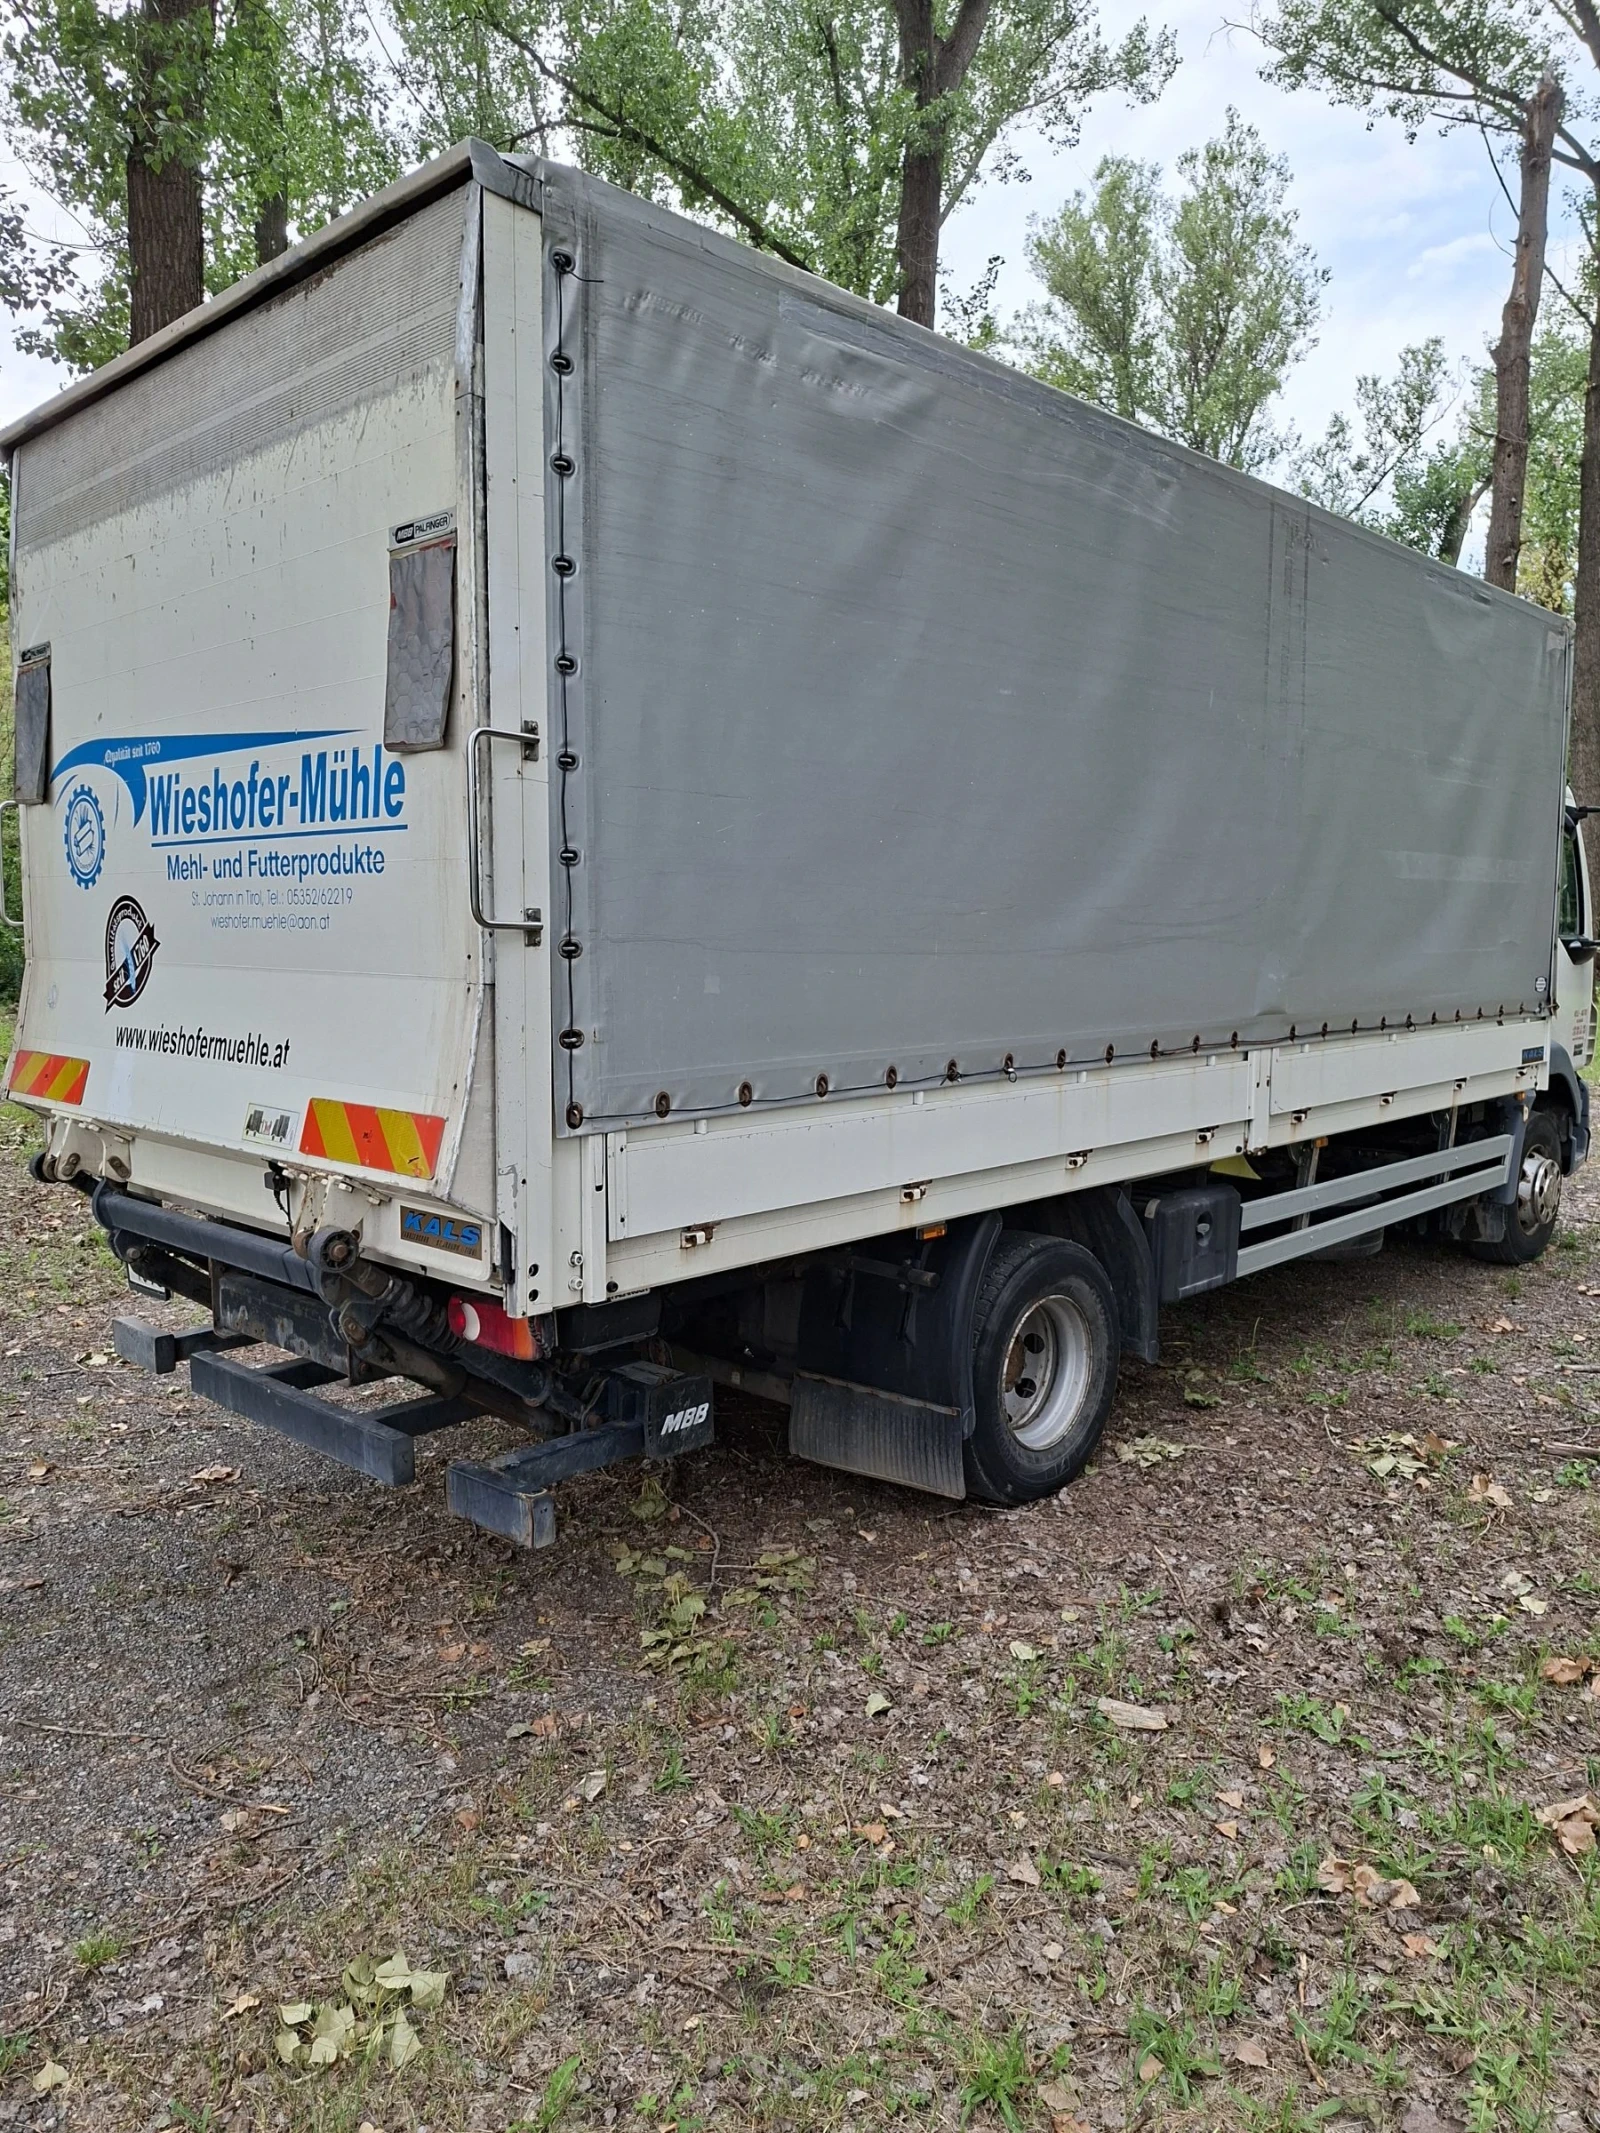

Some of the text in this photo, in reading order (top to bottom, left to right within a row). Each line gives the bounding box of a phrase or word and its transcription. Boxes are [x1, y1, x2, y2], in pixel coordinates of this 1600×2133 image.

[397, 526, 414, 541] MBB
[144, 741, 161, 756] 1760
[149, 743, 406, 837] Wieshofer-Mühle
[166, 843, 385, 883] Mehl- und Futterprodukte
[191, 890, 200, 906] St.
[202, 889, 234, 906] Johann
[235, 890, 243, 905] in
[245, 889, 264, 907] Tirol,
[286, 887, 353, 907] 05352/62219
[210, 912, 331, 932] wieshofer.muehle@aon.at
[132, 934, 150, 967] 1760
[115, 1023, 291, 1068] www.wieshofermuehle.at
[404, 1210, 482, 1248] KALS
[660, 1402, 710, 1436] MBB
